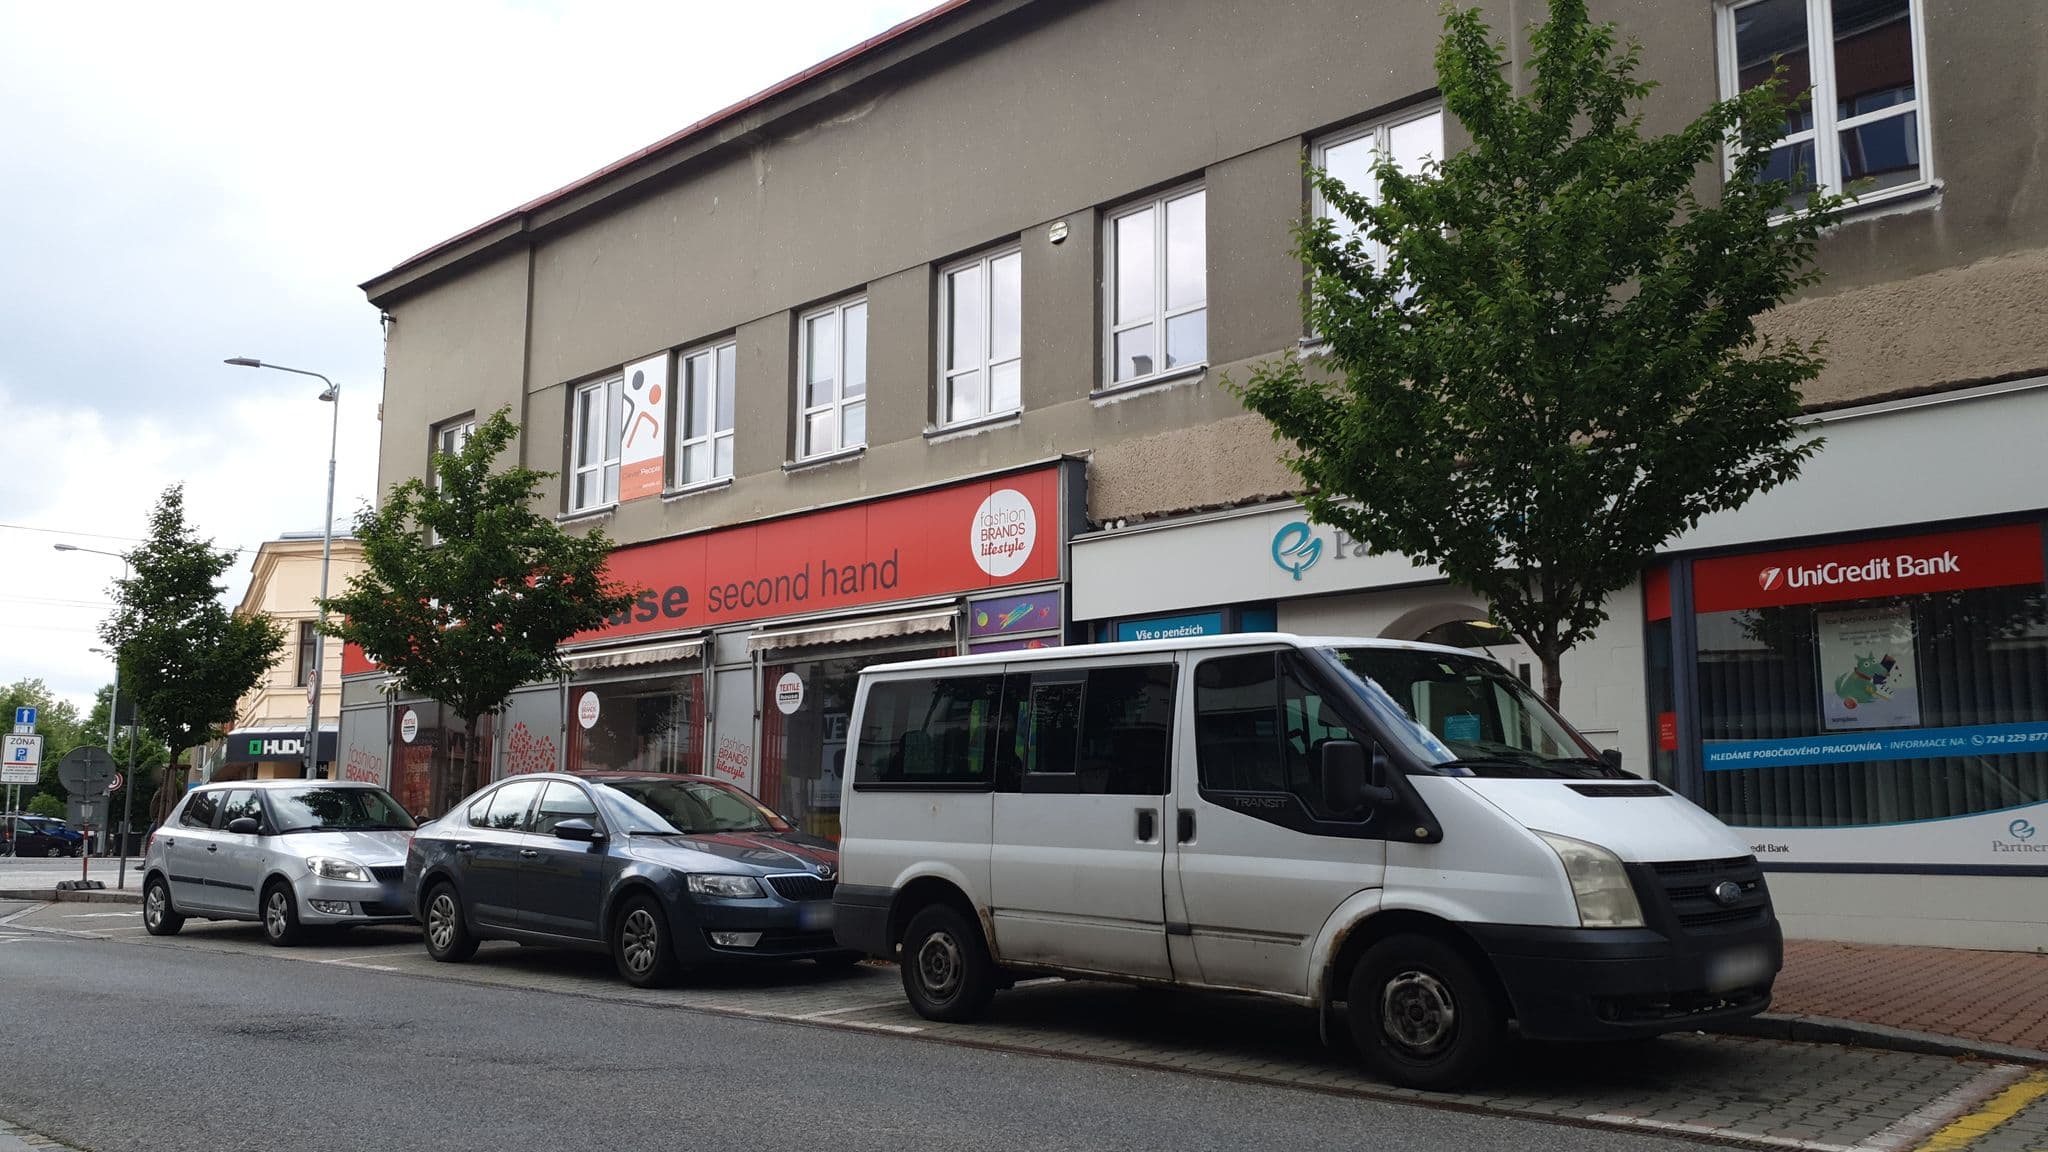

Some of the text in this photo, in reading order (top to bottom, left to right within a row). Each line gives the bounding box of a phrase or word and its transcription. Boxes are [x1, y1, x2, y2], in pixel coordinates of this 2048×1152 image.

[980, 507, 1026, 527] fashion
[981, 522, 1026, 541] BRANDS
[981, 537, 1026, 558] lifestyle
[1787, 550, 1961, 588] UniCredit Bank
[708, 563, 810, 613] second
[821, 548, 899, 597] hand
[1135, 629, 1153, 641] Vše
[1162, 624, 1204, 640] penězích
[780, 683, 800, 692] TEXTILE
[720, 734, 751, 757] fashion
[1710, 750, 1752, 761] HLEDÁME
[1753, 745, 1820, 759] POBOČKOVÉHO
[1822, 741, 1882, 754] PRACOVNÍKA
[1890, 738, 1947, 749] INFORMACE
[1949, 737, 1967, 746] NA:
[719, 747, 748, 767] BRANDS
[716, 758, 746, 780] lifestyle
[1233, 797, 1287, 808] TRANSIT
[1767, 843, 1790, 853] Bank
